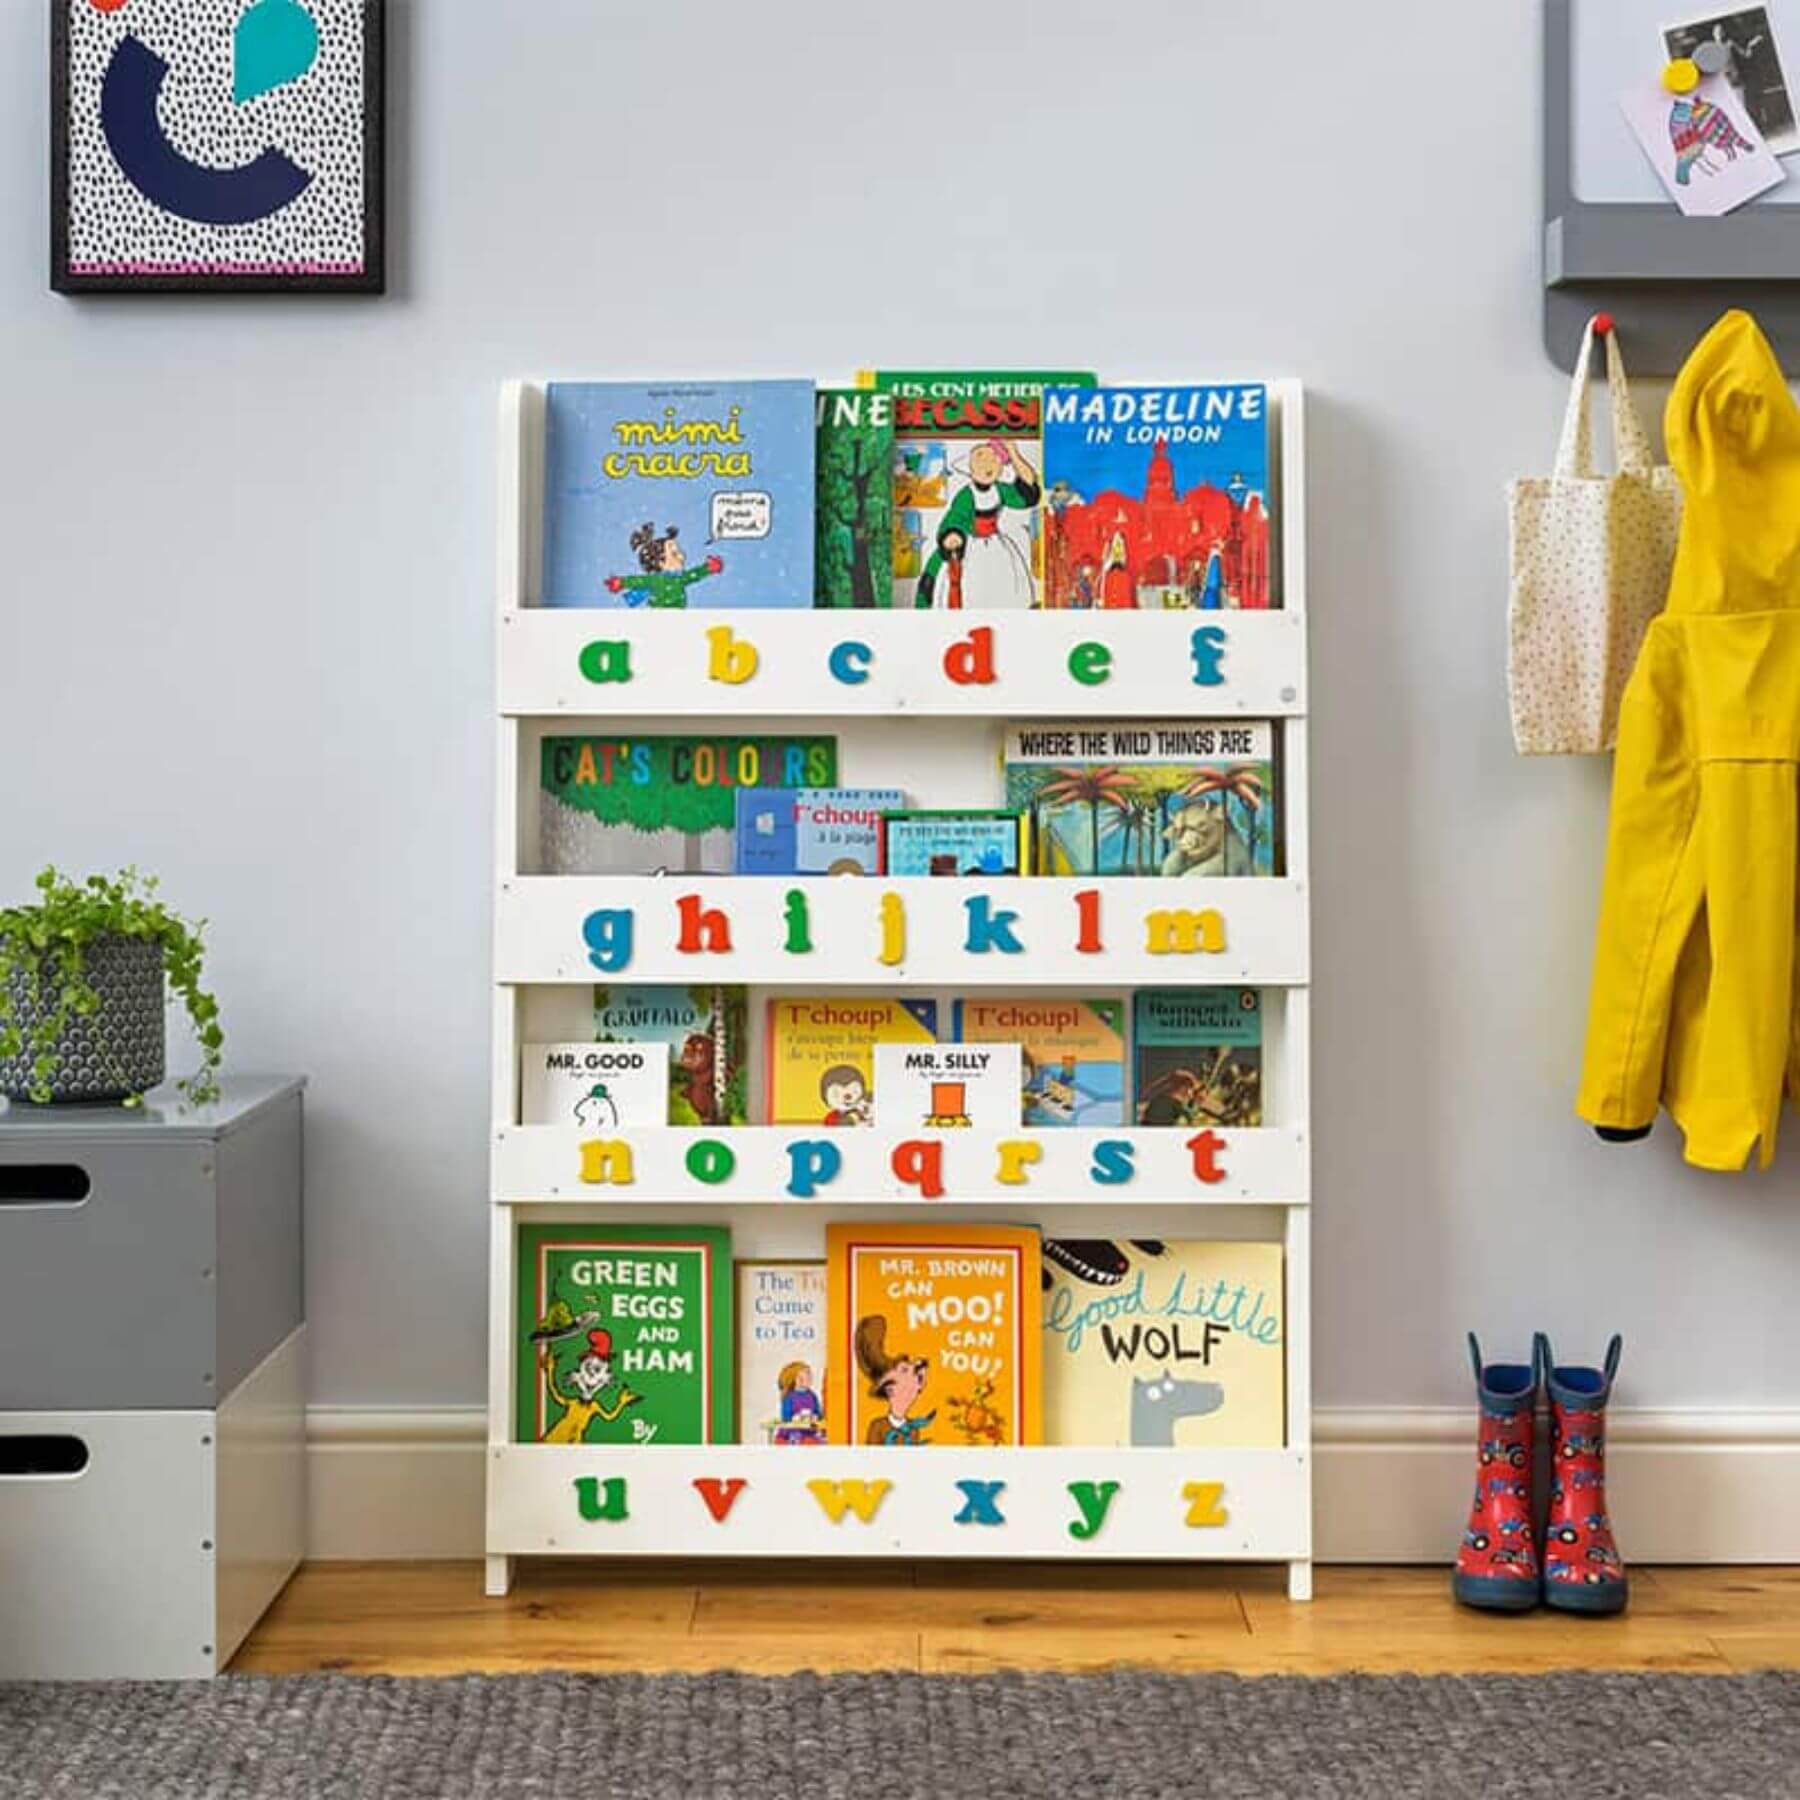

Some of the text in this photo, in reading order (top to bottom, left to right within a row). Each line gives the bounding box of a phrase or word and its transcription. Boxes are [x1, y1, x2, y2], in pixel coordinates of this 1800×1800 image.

[930, 383, 972, 397] CENT
[1046, 389, 1263, 423] MADELINE
[613, 405, 746, 445] mimi
[1086, 425, 1221, 444] IN LONDON
[602, 451, 754, 480] cracra
[580, 626, 1225, 685] a b c d e f
[1019, 730, 1253, 756] WHERE THE WILD THINGS ARE
[554, 745, 827, 785] CAT'S COLOURS
[584, 889, 1226, 972] g h i j k l m
[973, 1007, 1079, 1033] T'choupi
[546, 1053, 644, 1069] MR. GOOD
[905, 1052, 991, 1069] MR. SILLY
[580, 1130, 1227, 1199] n o p q r s t
[571, 1261, 678, 1287] GREEN
[757, 1272, 793, 1290] The
[880, 1260, 1006, 1277] MR. BROWN
[887, 1281, 933, 1299] CAN
[611, 1294, 685, 1320] EGGS
[755, 1296, 815, 1314] Came
[907, 1291, 1005, 1331] MOO!
[636, 1327, 680, 1343] AND
[755, 1321, 815, 1339] to Tea
[948, 1331, 995, 1348] CAN
[1101, 1322, 1231, 1366] WOLF
[623, 1350, 694, 1373] HAM
[631, 1418, 658, 1444] By
[574, 1477, 1228, 1539] u v w x y z
